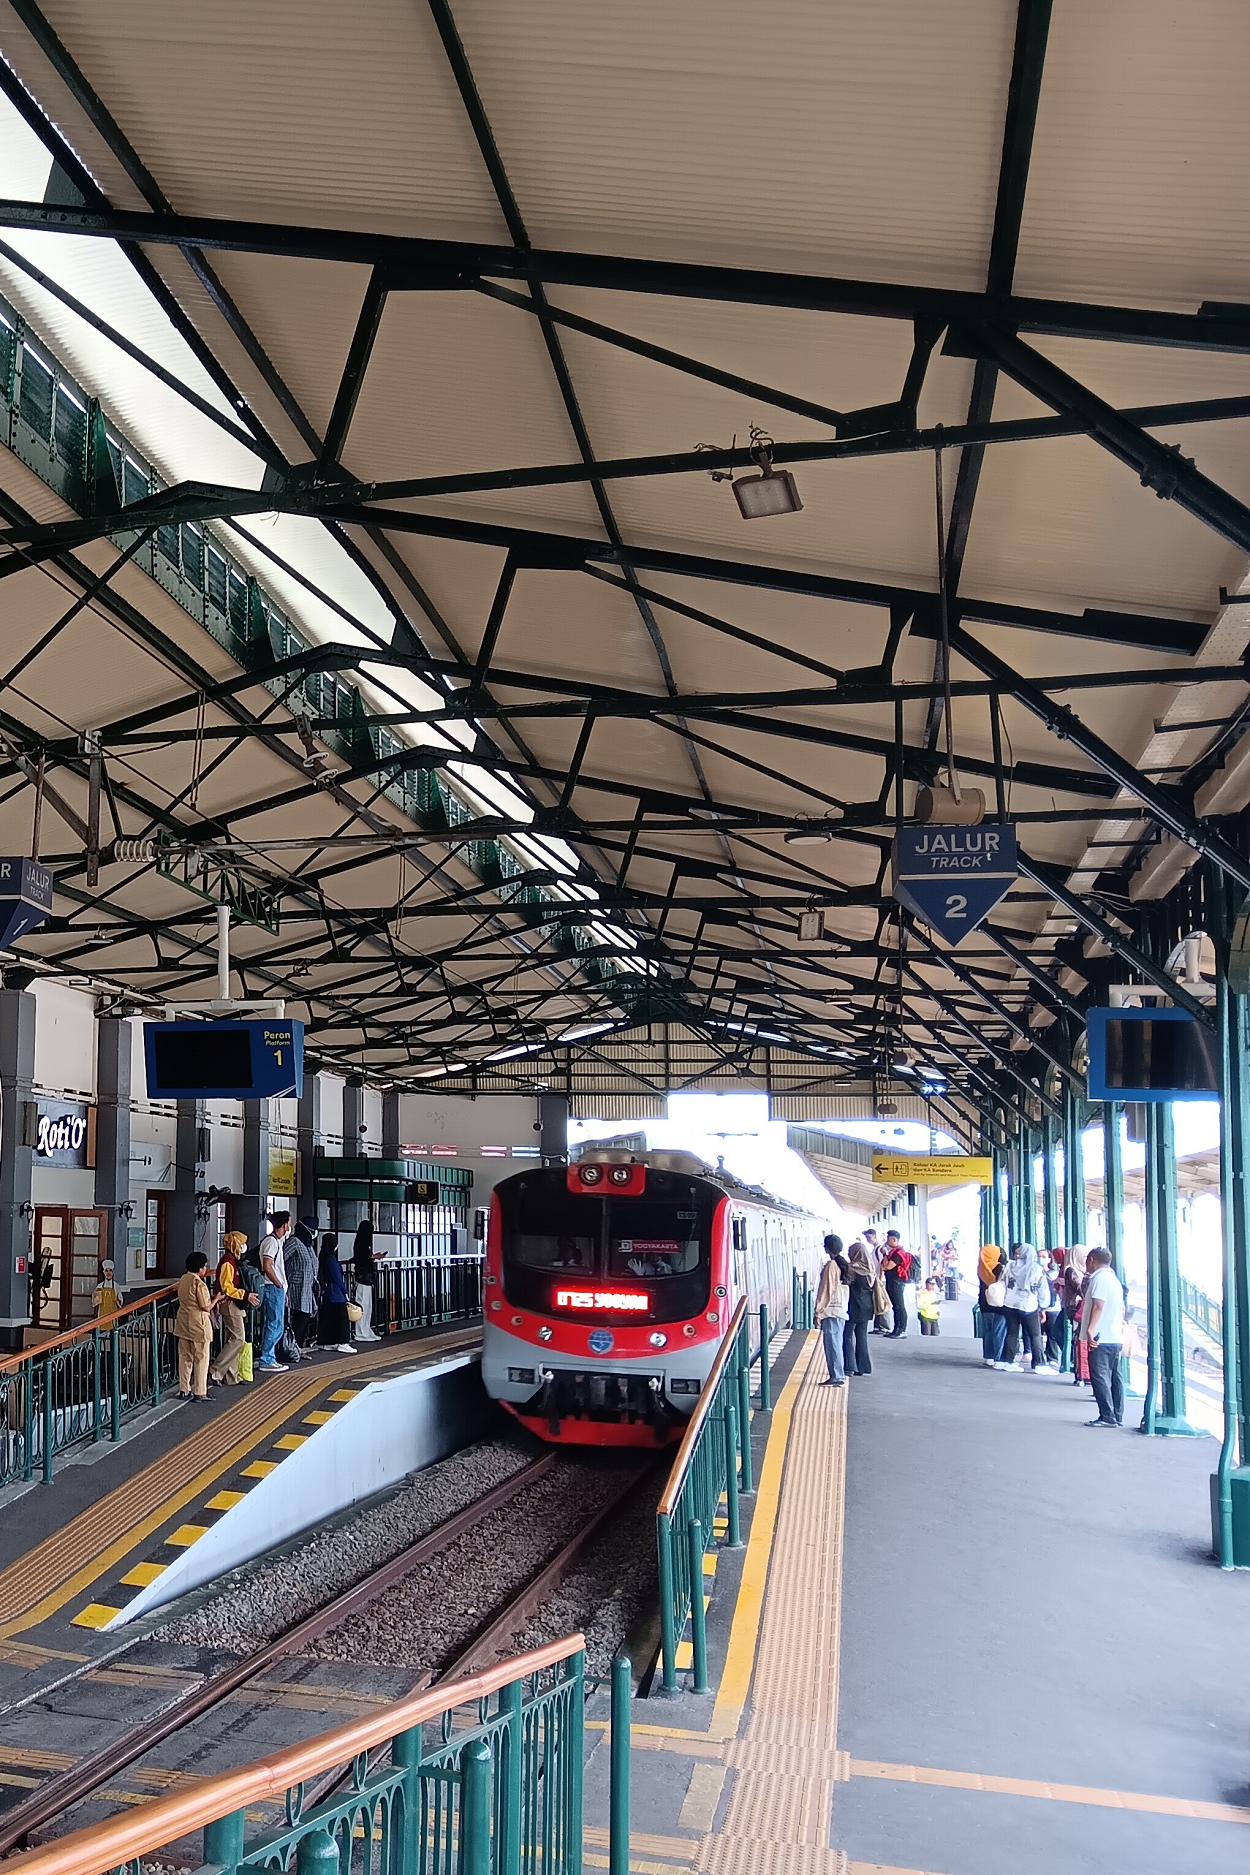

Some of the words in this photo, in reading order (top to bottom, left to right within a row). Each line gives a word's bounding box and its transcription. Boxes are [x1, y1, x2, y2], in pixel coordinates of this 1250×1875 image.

[914, 832, 1000, 854] JALUR
[930, 855, 984, 869] TRACK
[26, 866, 50, 891] JALUR
[944, 894, 968, 918] 2
[13, 918, 29, 936] 1
[273, 1049, 282, 1066] 1
